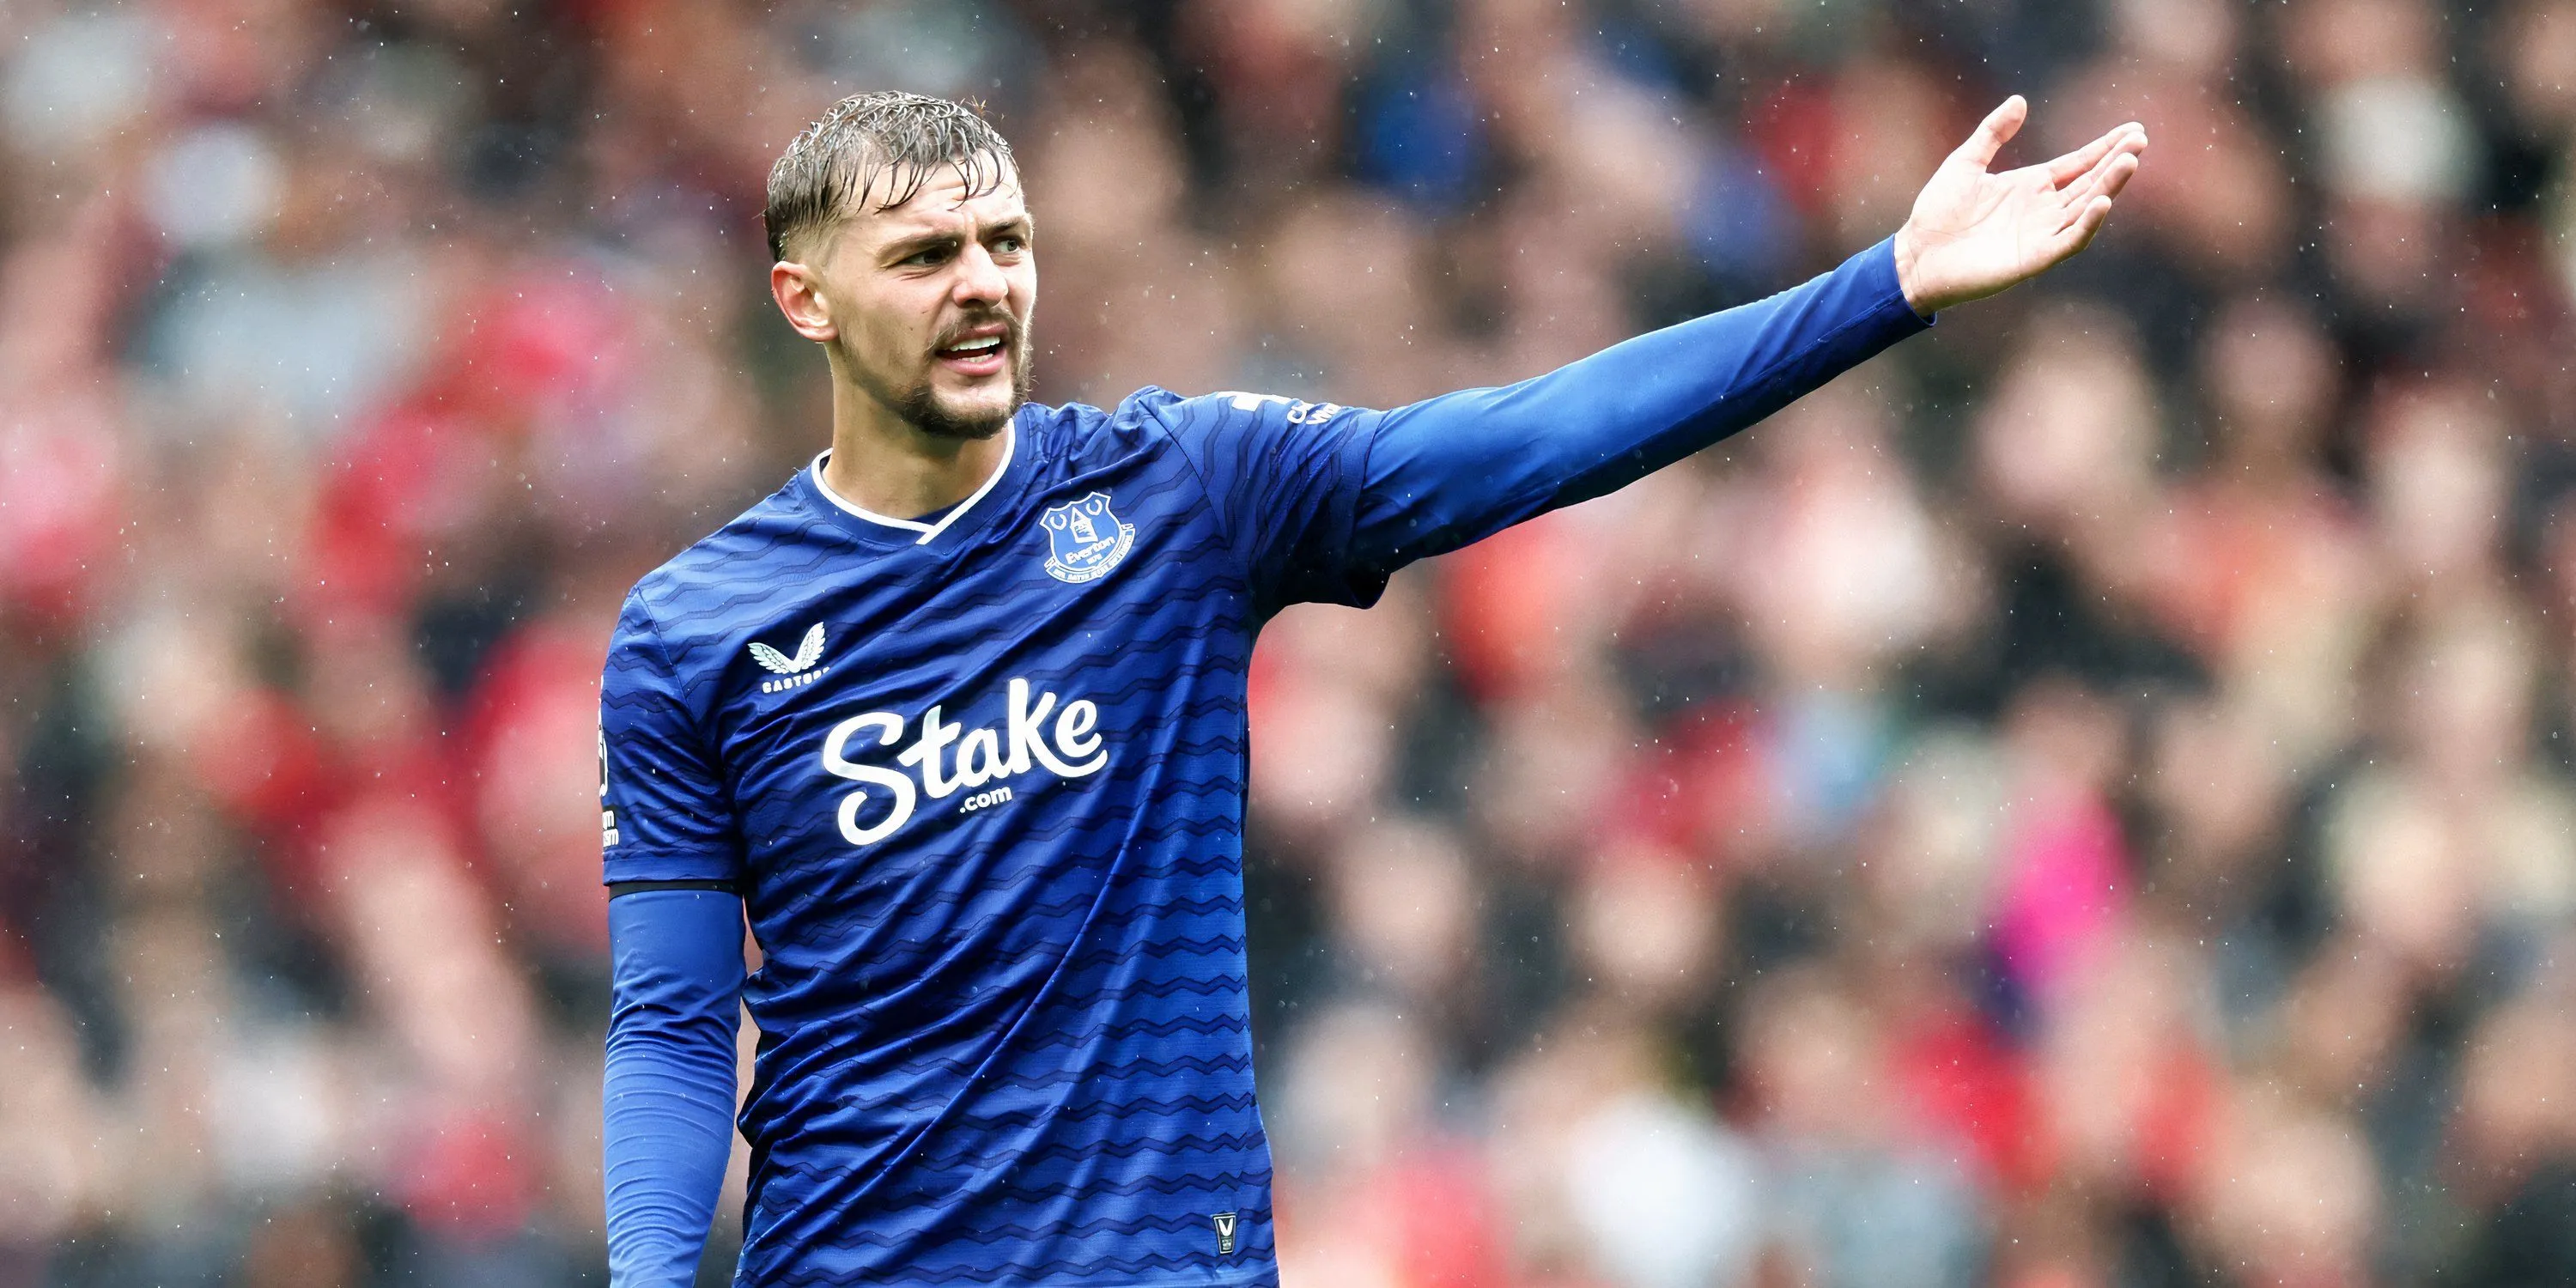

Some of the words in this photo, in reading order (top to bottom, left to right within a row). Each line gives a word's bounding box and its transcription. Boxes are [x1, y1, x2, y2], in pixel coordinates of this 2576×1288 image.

[1065, 536, 1116, 565] Everton
[823, 677, 1109, 846] Stake
[959, 786, 1013, 814] .com
